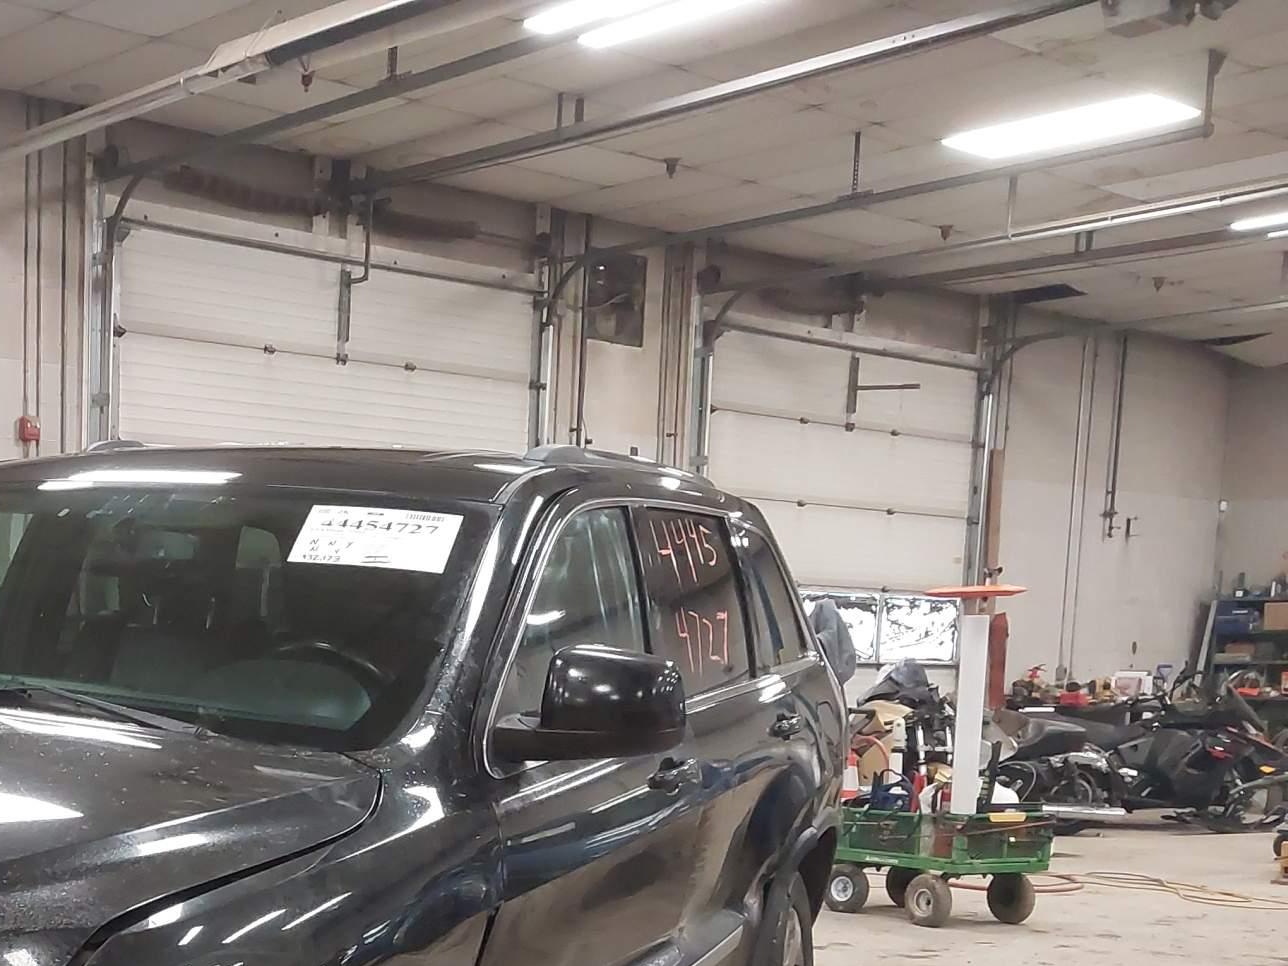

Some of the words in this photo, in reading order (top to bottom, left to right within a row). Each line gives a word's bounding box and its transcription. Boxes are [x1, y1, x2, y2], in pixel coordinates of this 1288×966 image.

[320, 518, 439, 534] 44454727
[649, 519, 717, 586] 4445
[675, 607, 728, 676] 4727
